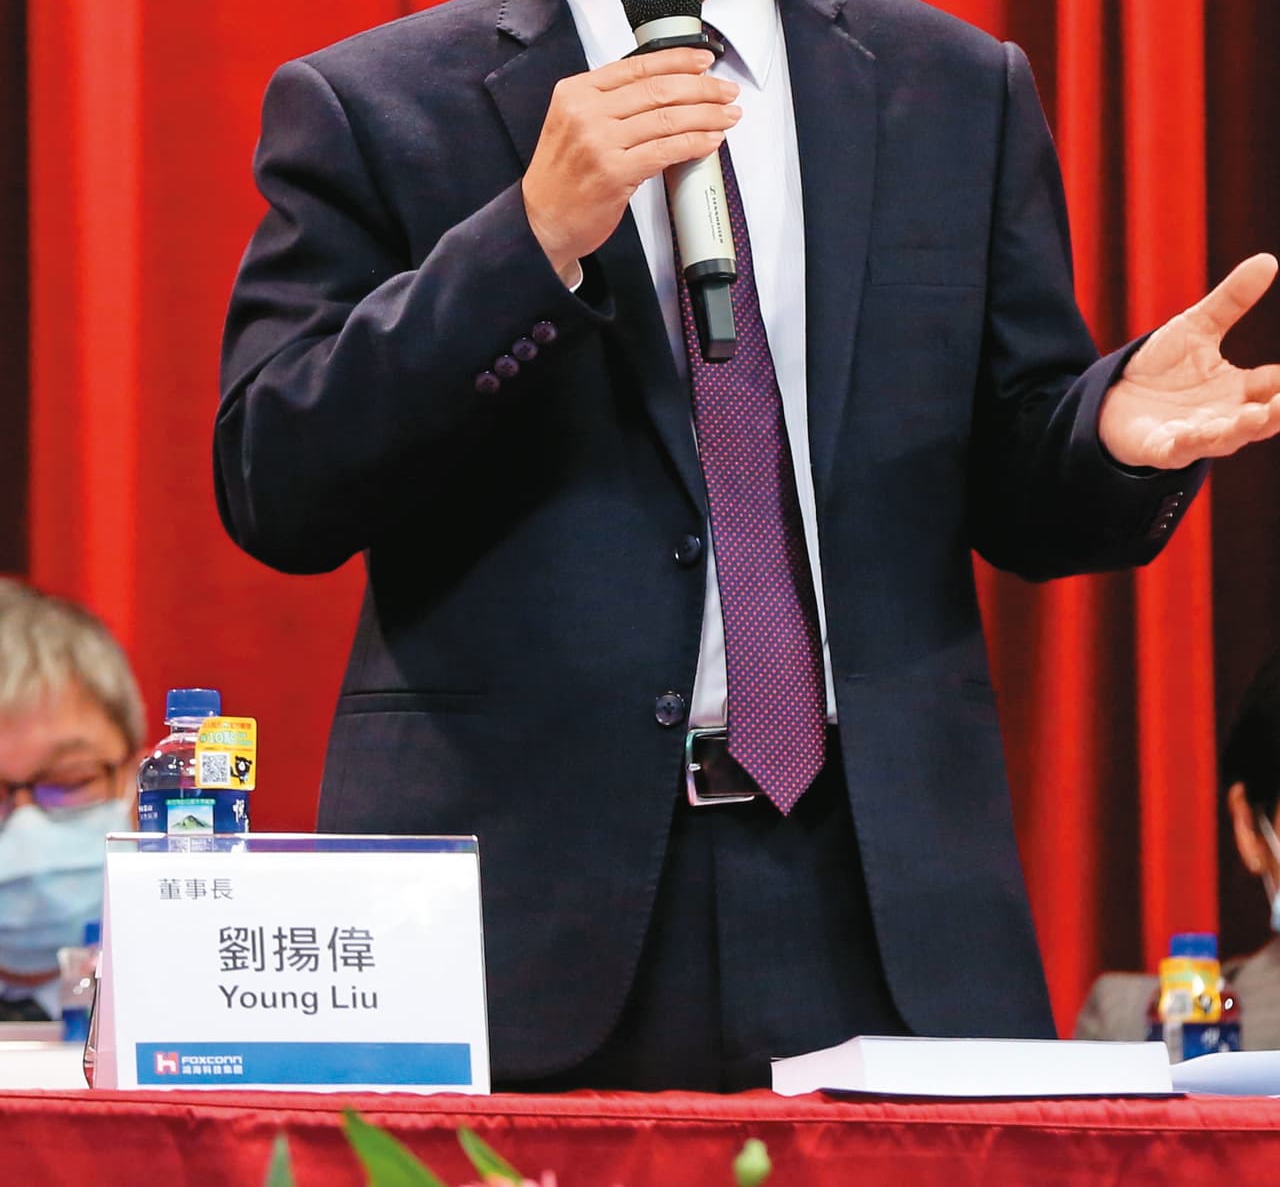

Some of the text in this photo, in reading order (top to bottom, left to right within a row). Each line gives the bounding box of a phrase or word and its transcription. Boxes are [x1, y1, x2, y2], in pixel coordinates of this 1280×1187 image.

[158, 878, 233, 900] 董事長
[219, 926, 376, 973] 劉揚偉
[218, 984, 378, 1015] Young Liu
[181, 1055, 243, 1065] FOXCONN
